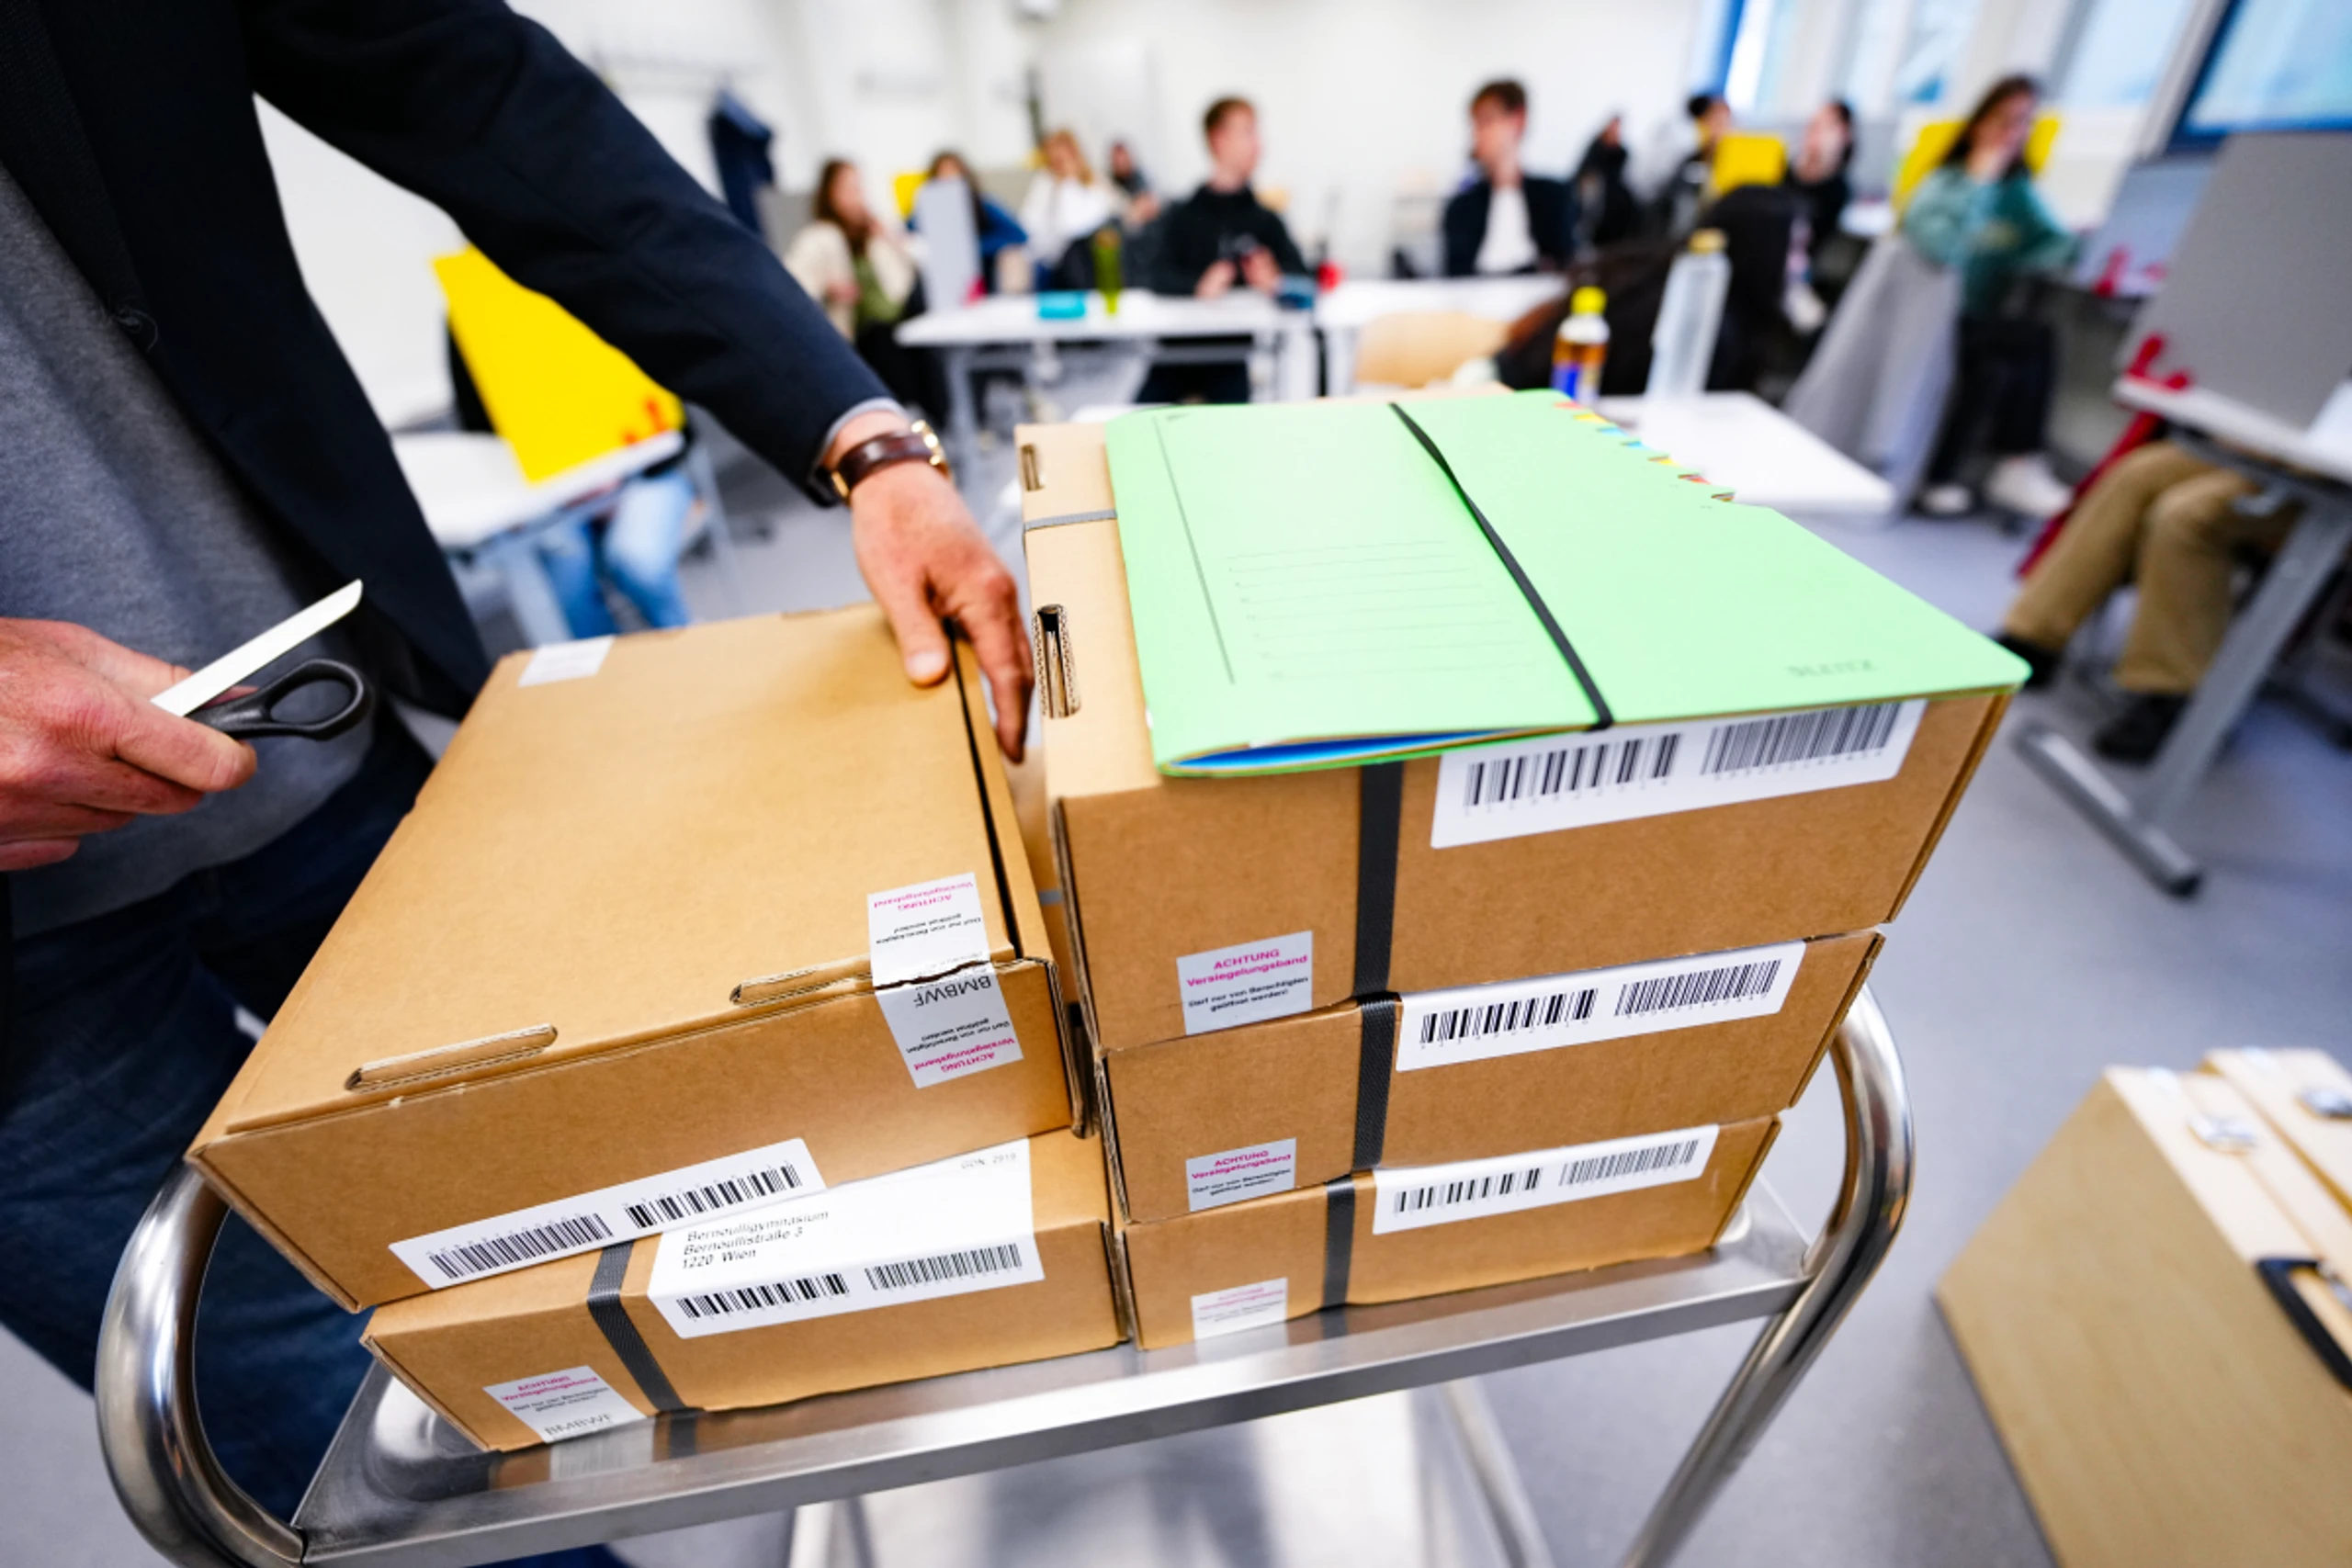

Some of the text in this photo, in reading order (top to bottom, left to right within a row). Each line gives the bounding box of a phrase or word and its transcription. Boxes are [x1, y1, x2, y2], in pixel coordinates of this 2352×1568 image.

[1187, 954, 1308, 987] Versiegelungsband
[1214, 949, 1280, 970] ACHTUNG
[913, 976, 991, 1008] BMBWF
[913, 1037, 1015, 1071] Versiegelungsband
[940, 1052, 995, 1072] ACHTUNG
[1214, 1150, 1269, 1167] ACHTUNG
[687, 1212, 829, 1242] Bernoulligymnasium
[683, 1249, 756, 1269] 1220 Wien
